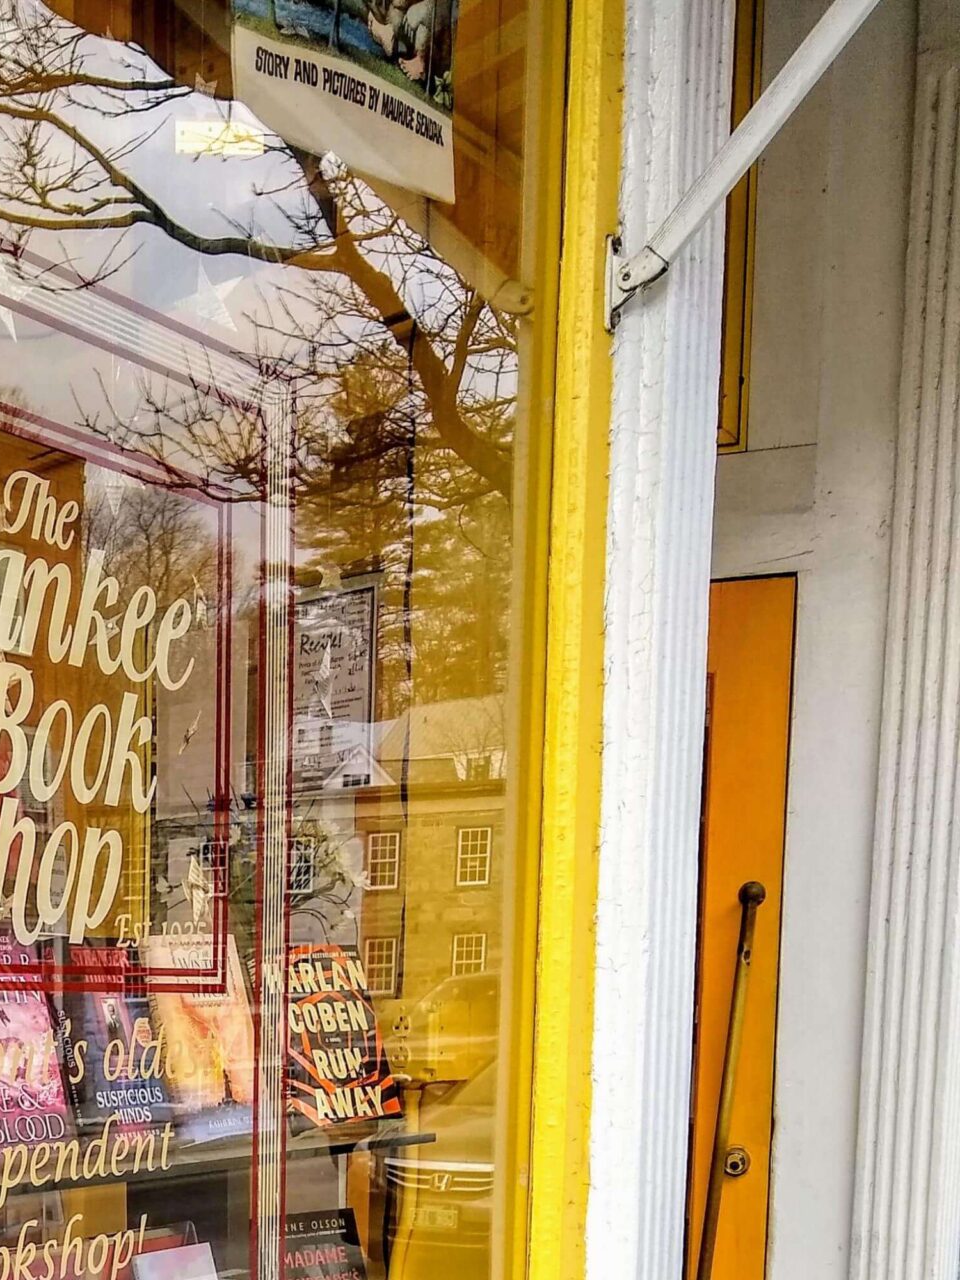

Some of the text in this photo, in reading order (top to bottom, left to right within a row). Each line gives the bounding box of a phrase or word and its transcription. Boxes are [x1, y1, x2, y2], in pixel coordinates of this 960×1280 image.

[256, 46, 444, 146] STORY AND PICTURES BY MAURICE SENDAK
[3, 470, 80, 551] The
[289, 1000, 369, 1034] COBEN
[312, 1048, 363, 1080] RUN
[96, 1087, 164, 1108] SUSPICIOUS
[315, 1085, 385, 1120] AWAY
[114, 1106, 153, 1126] MINDS
[311, 1218, 346, 1230] OLSON
[284, 1246, 348, 1270] MADAME
